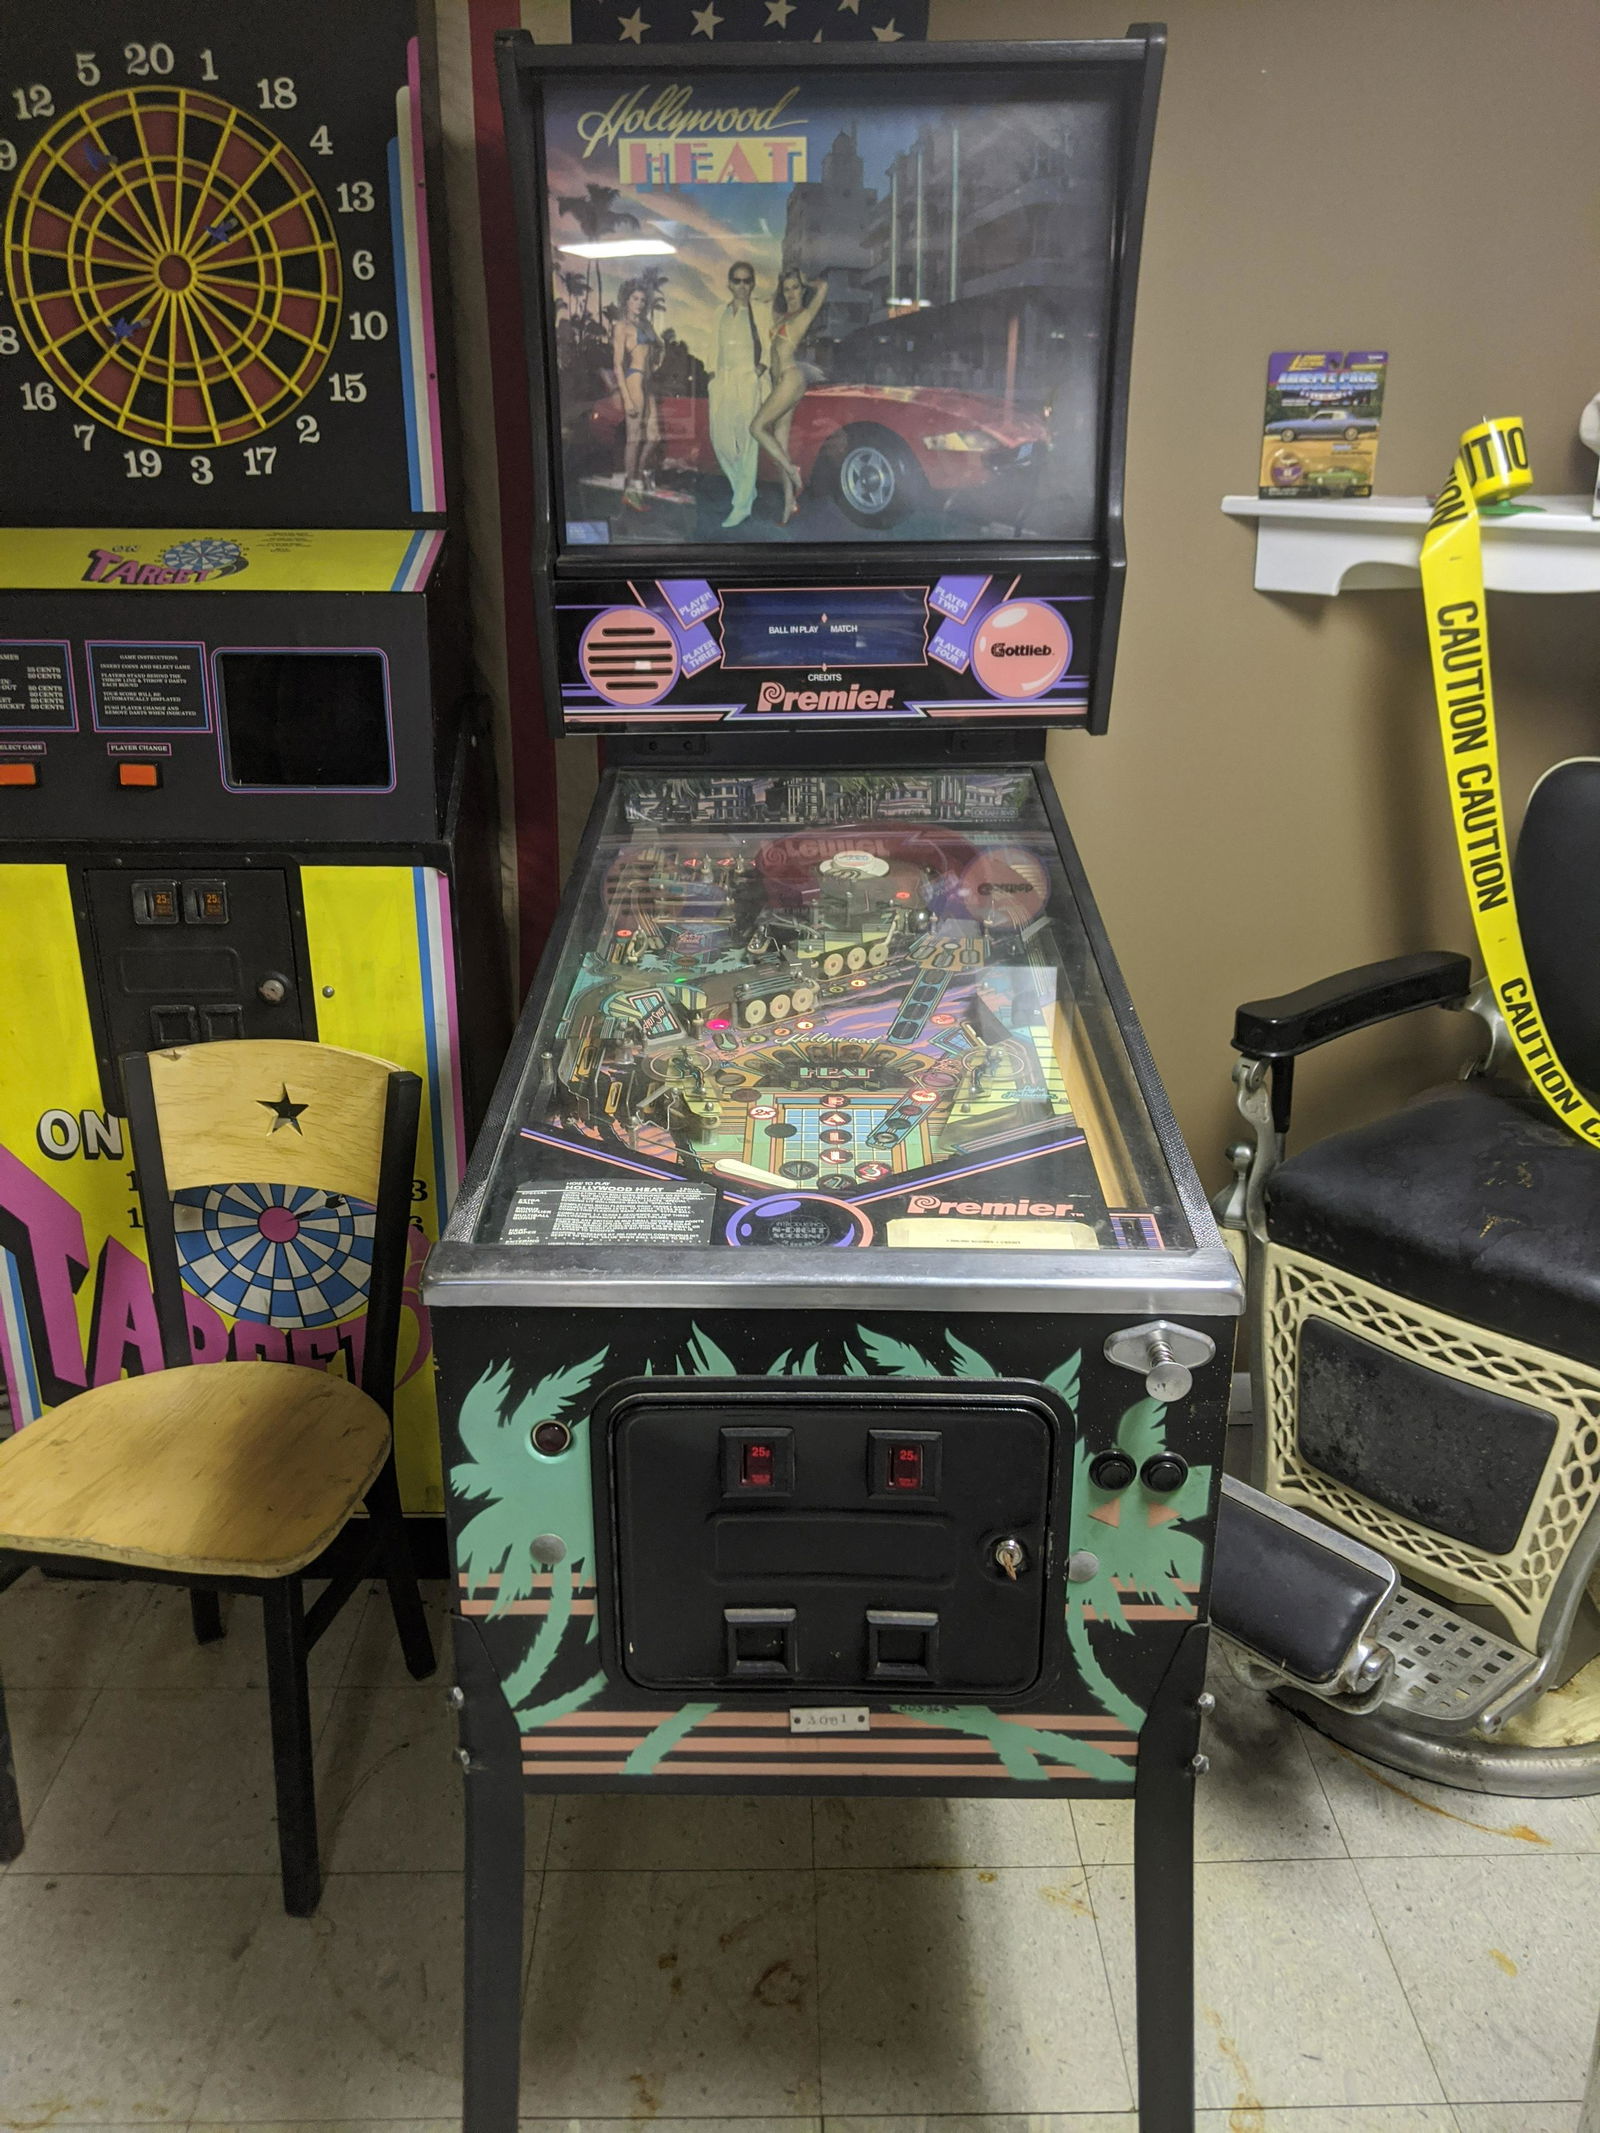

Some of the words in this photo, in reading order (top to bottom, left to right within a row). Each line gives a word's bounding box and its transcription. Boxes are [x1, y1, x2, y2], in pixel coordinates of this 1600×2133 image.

[76, 53, 100, 87] 5
[124, 42, 174, 76] 20
[201, 50, 219, 82] 1
[13, 85, 55, 120] 12
[257, 77, 298, 110] 18
[577, 84, 808, 159] Hollywood
[310, 125, 334, 156] 4
[629, 141, 803, 192] HEAT
[336, 181, 375, 213] 13
[352, 250, 375, 281] 6
[349, 311, 388, 341] 10
[20, 382, 58, 412] 16
[329, 373, 367, 402] 15
[73, 425, 96, 452] 7
[296, 416, 320, 444] 2
[123, 449, 162, 478] 19
[190, 456, 214, 485] 3
[243, 447, 278, 476] 17
[82, 548, 214, 585] TARGET
[679, 592, 712, 616] PLAYER
[690, 603, 709, 617] ONE
[935, 586, 968, 610] PLAYER
[938, 597, 959, 613] TWO
[769, 626, 788, 634] BALL
[800, 625, 819, 633] PLAY
[830, 625, 858, 633] MATCH
[682, 640, 715, 663] PLAYER
[690, 648, 717, 668] THREE
[935, 636, 967, 660] PLAYER
[935, 647, 960, 664] FOUR
[991, 643, 1052, 657] Gottlieb
[808, 673, 842, 682] CREDITS
[1437, 600, 1489, 755] CAUTION
[757, 681, 895, 712] Premier
[1456, 762, 1509, 913] CAUTION
[1500, 977, 1583, 1115] CAUTION
[37, 1110, 125, 1160] ON
[868, 1164, 883, 1177] 3
[907, 1195, 1074, 1217] Premier
